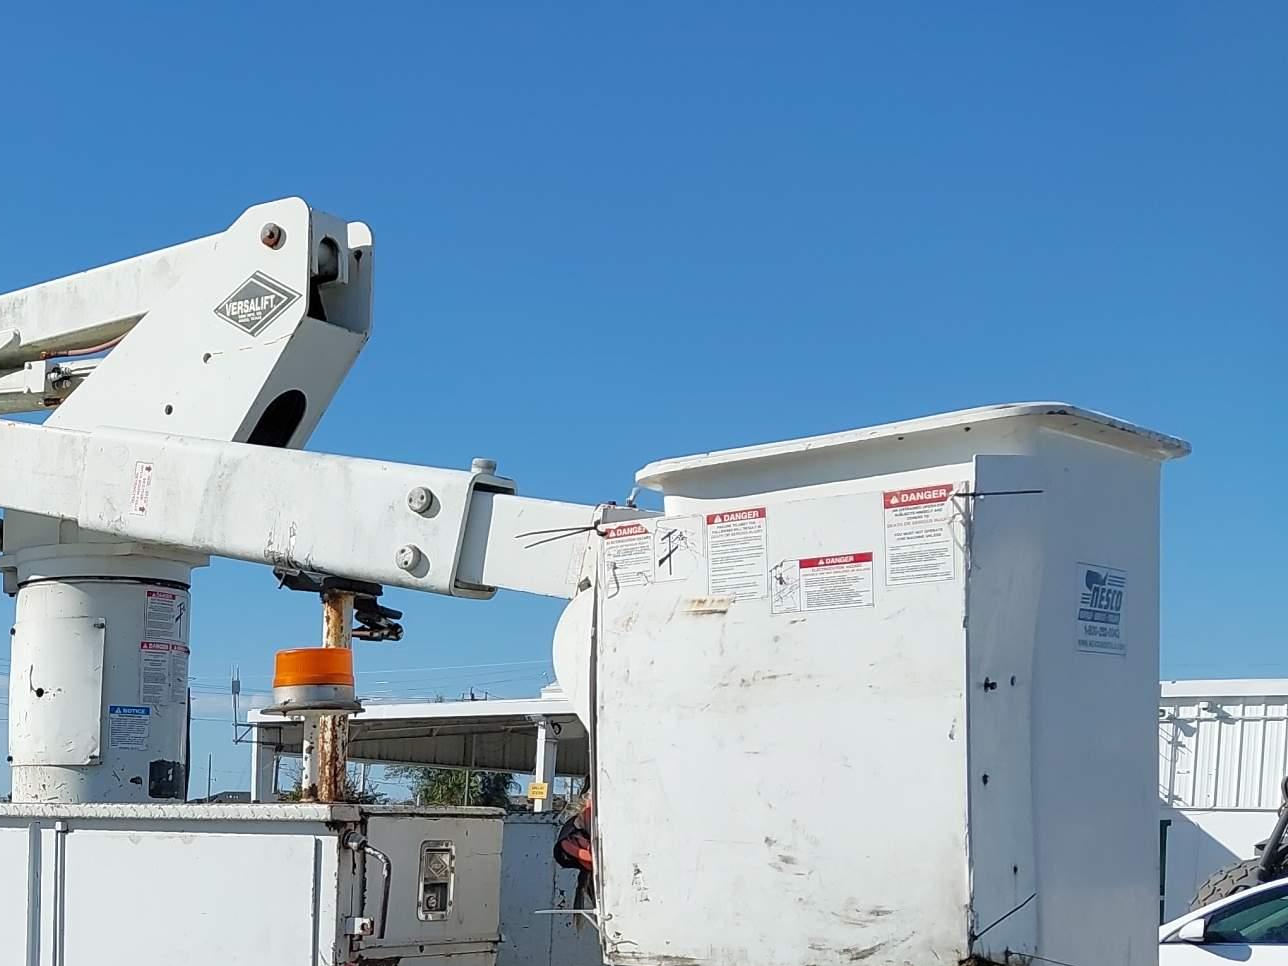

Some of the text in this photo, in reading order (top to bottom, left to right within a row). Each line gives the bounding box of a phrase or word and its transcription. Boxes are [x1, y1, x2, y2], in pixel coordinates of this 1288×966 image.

[225, 294, 276, 316] VERSALIFT
[901, 489, 947, 503] DANGER
[723, 510, 760, 522] DANGER
[825, 555, 855, 565] DANGER
